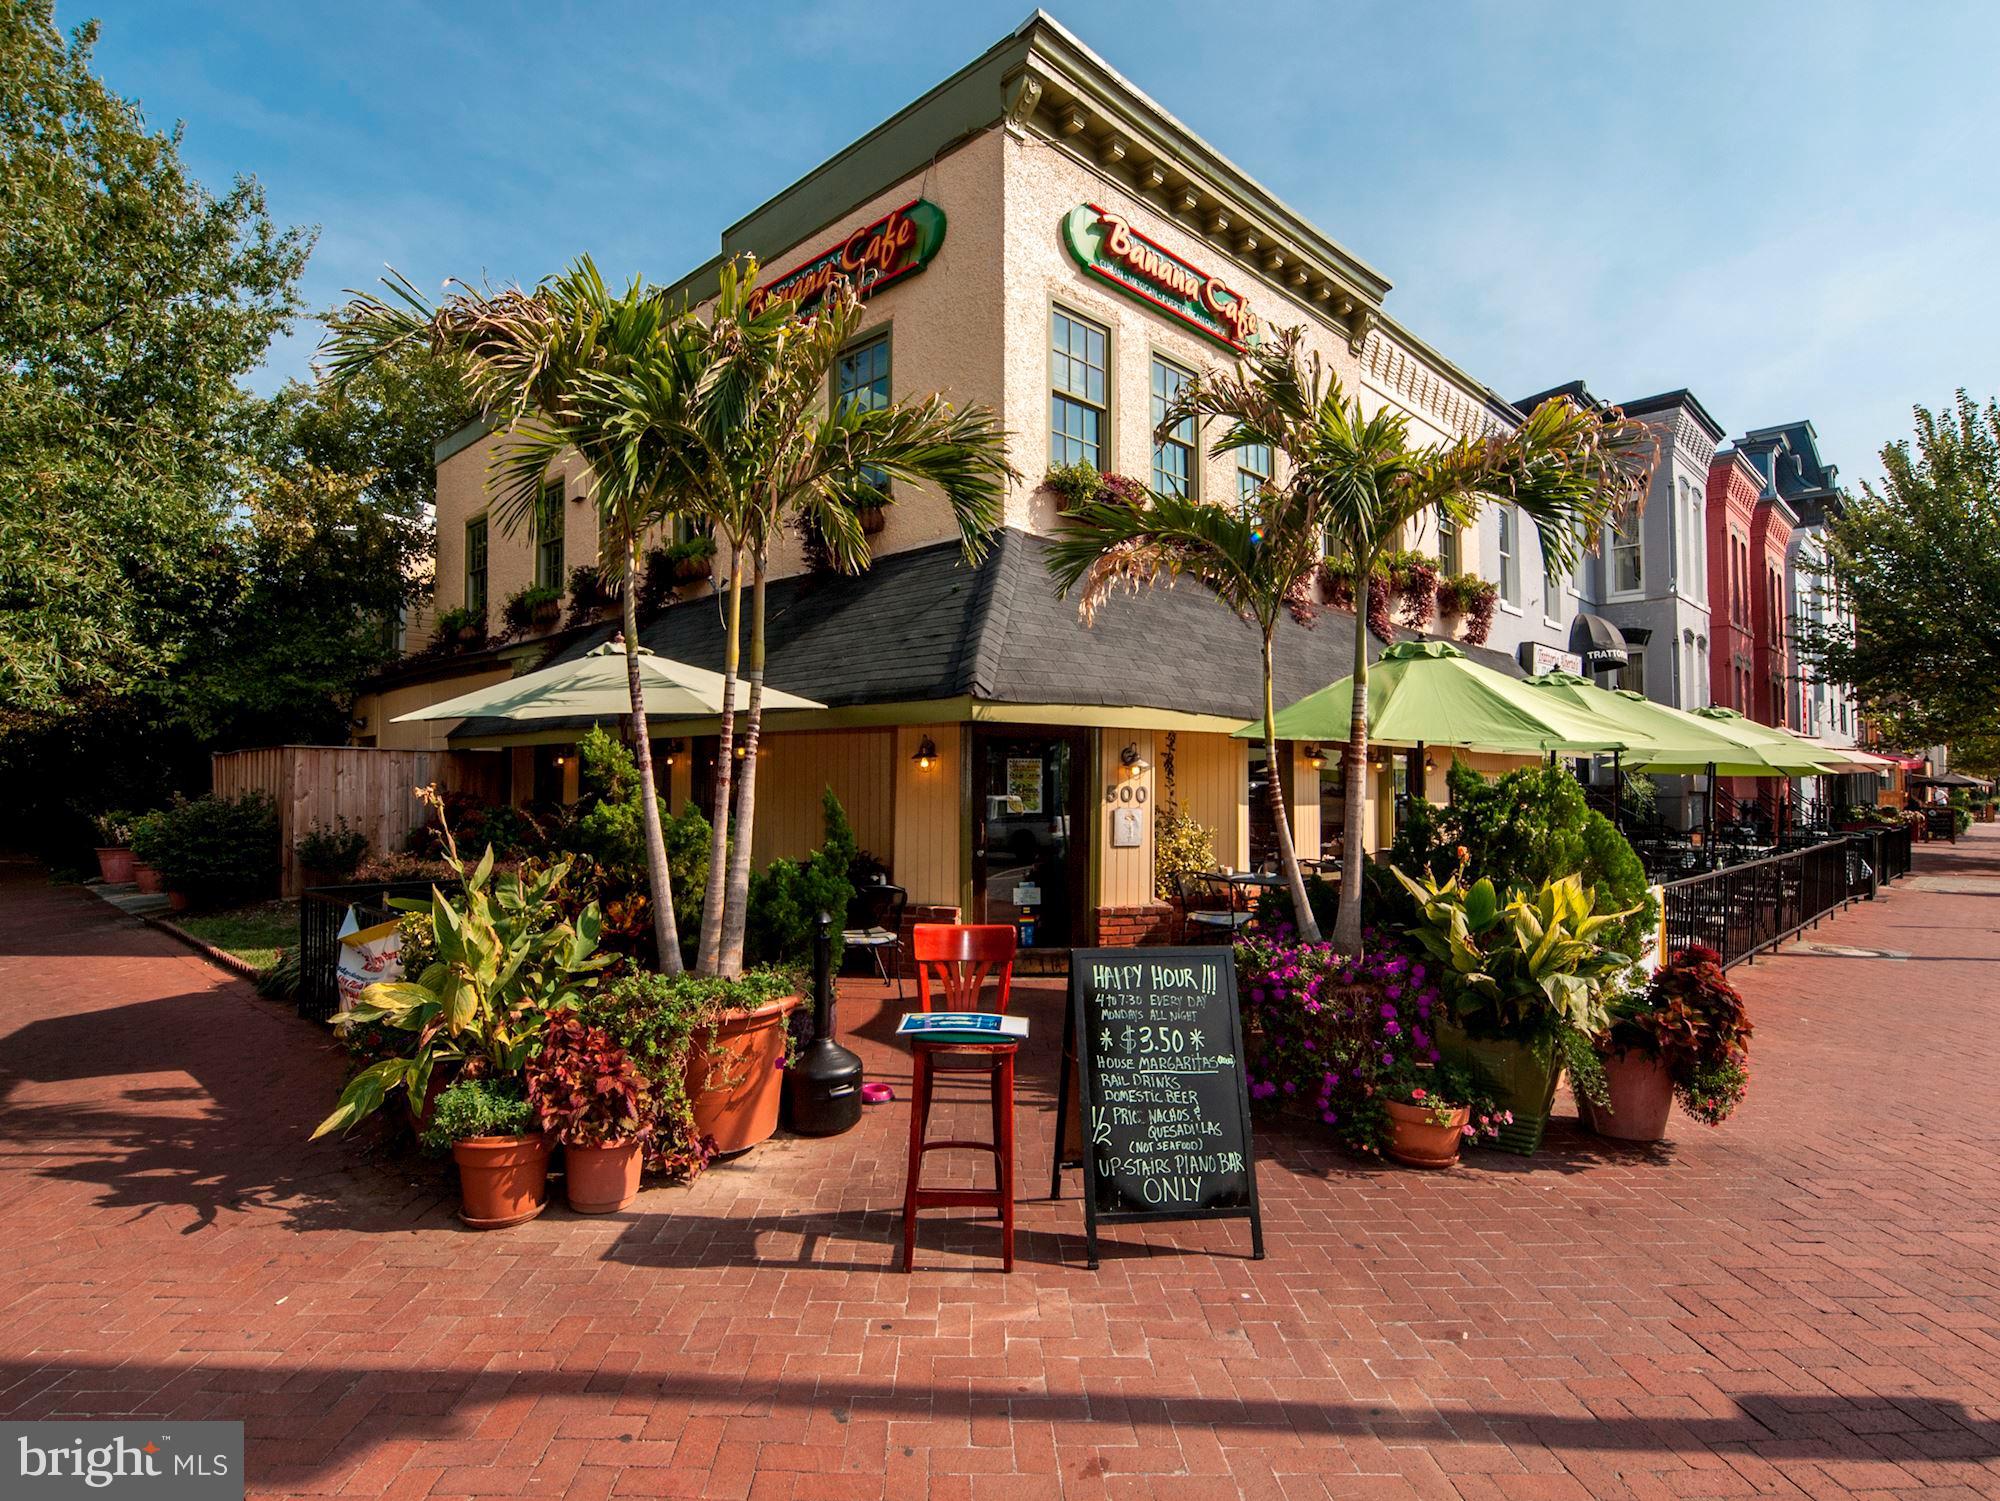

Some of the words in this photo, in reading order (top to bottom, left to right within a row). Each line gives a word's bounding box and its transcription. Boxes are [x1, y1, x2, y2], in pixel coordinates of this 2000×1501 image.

[745, 262, 833, 322] Bnana
[841, 211, 911, 271] Cafe
[1098, 213, 1200, 302] Banana
[1203, 277, 1258, 341] Cafe
[1106, 784, 1148, 804] 500
[1092, 963, 1142, 990] HAPPY
[1149, 994, 1183, 1007] EVERY
[1187, 995, 1208, 1009] DAY
[1101, 1009, 1144, 1023] MONDAYS
[1149, 1009, 1168, 1021] ALL
[1169, 1009, 1198, 1022] NIGHT
[1119, 1024, 1185, 1055] $3.50
[1096, 1054, 1136, 1070] HOUSE
[1138, 1052, 1219, 1072] MARGARITAS
[1100, 1072, 1130, 1088] RAIL
[1132, 1073, 1182, 1091] DRINKS
[1104, 1089, 1164, 1103] DOMESTIC
[1165, 1090, 1199, 1105] BEER
[1148, 1108, 1190, 1125] NACHOS
[1128, 1140, 1154, 1154] (NOT
[1156, 1138, 1204, 1152] SEAFOOD)
[1099, 1156, 1172, 1178] UP-STAIRS
[1174, 1152, 1217, 1175] PIANO
[1217, 1151, 1246, 1175] BAR
[1143, 1175, 1202, 1204] ONLY
